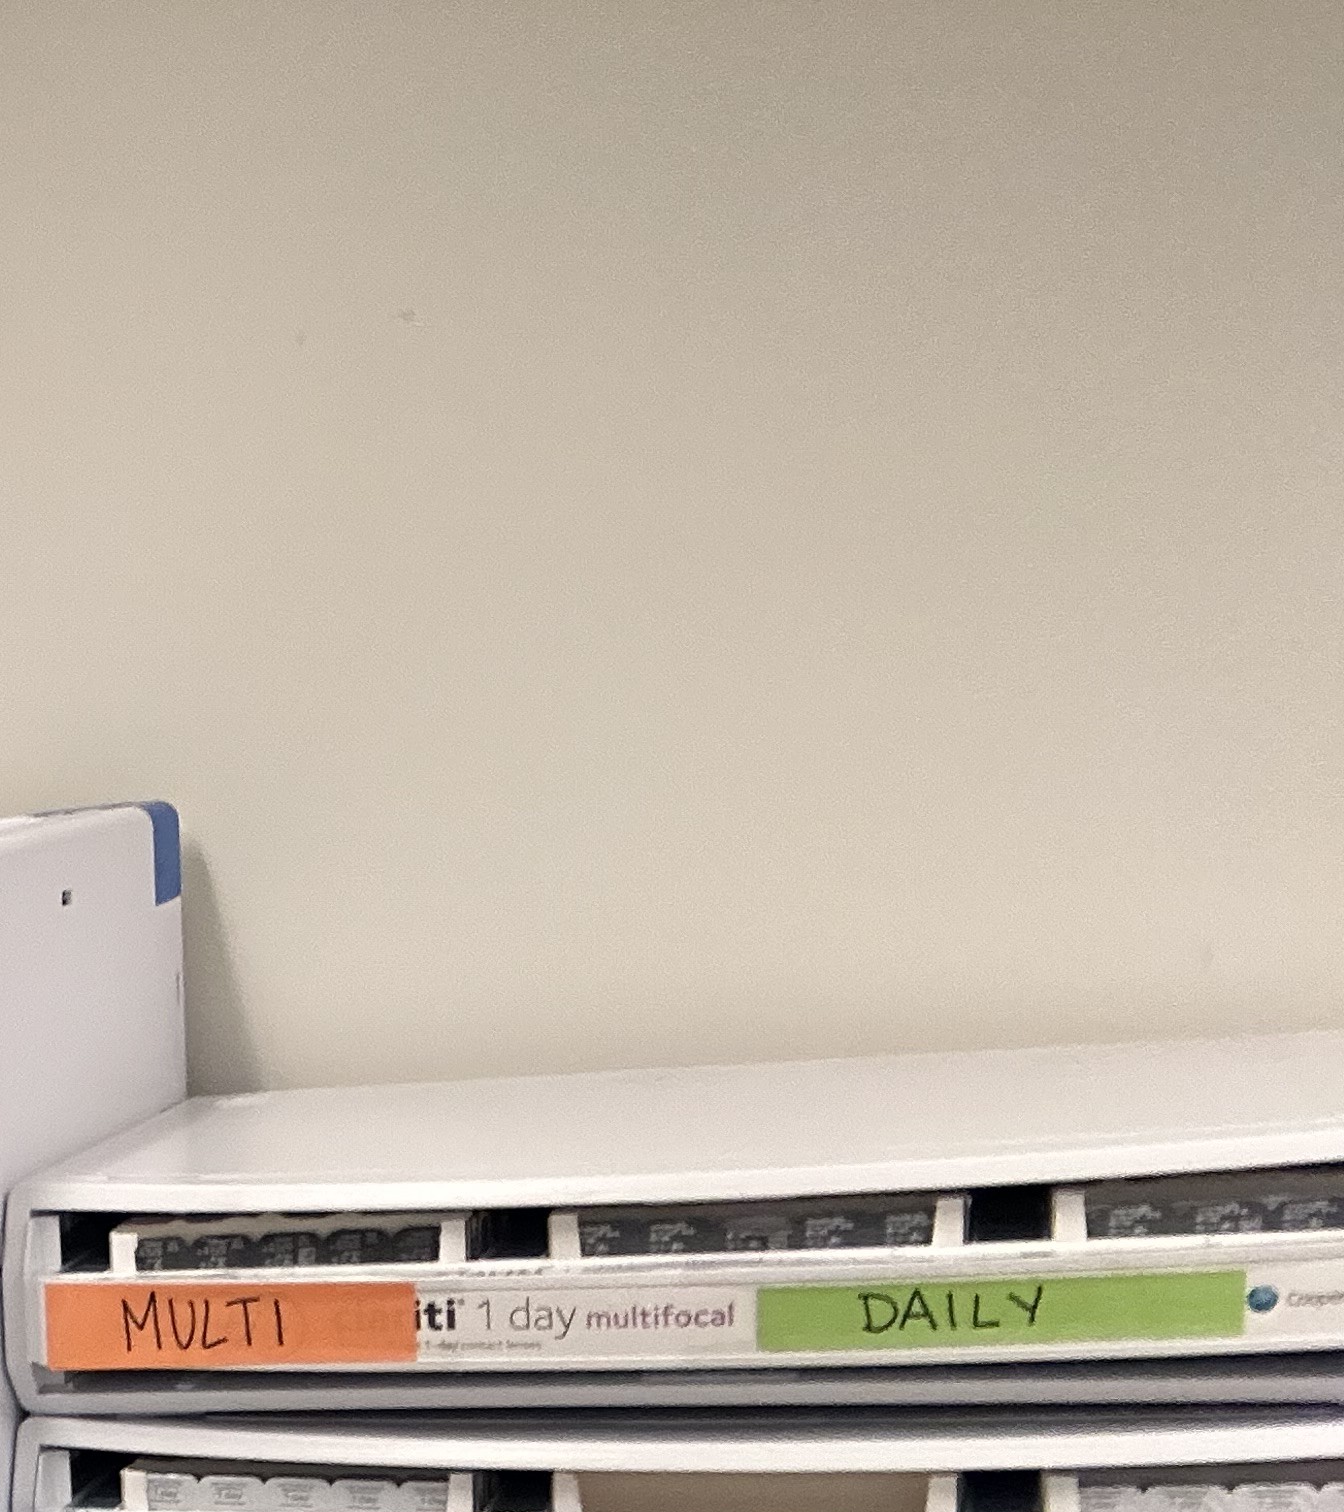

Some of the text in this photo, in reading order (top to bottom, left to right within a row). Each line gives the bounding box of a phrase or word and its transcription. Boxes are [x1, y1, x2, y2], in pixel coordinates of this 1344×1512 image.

[121, 1290, 284, 1353] MULTI
[477, 1296, 735, 1340] 1 day multifocal
[858, 1285, 1045, 1335] DAILY
